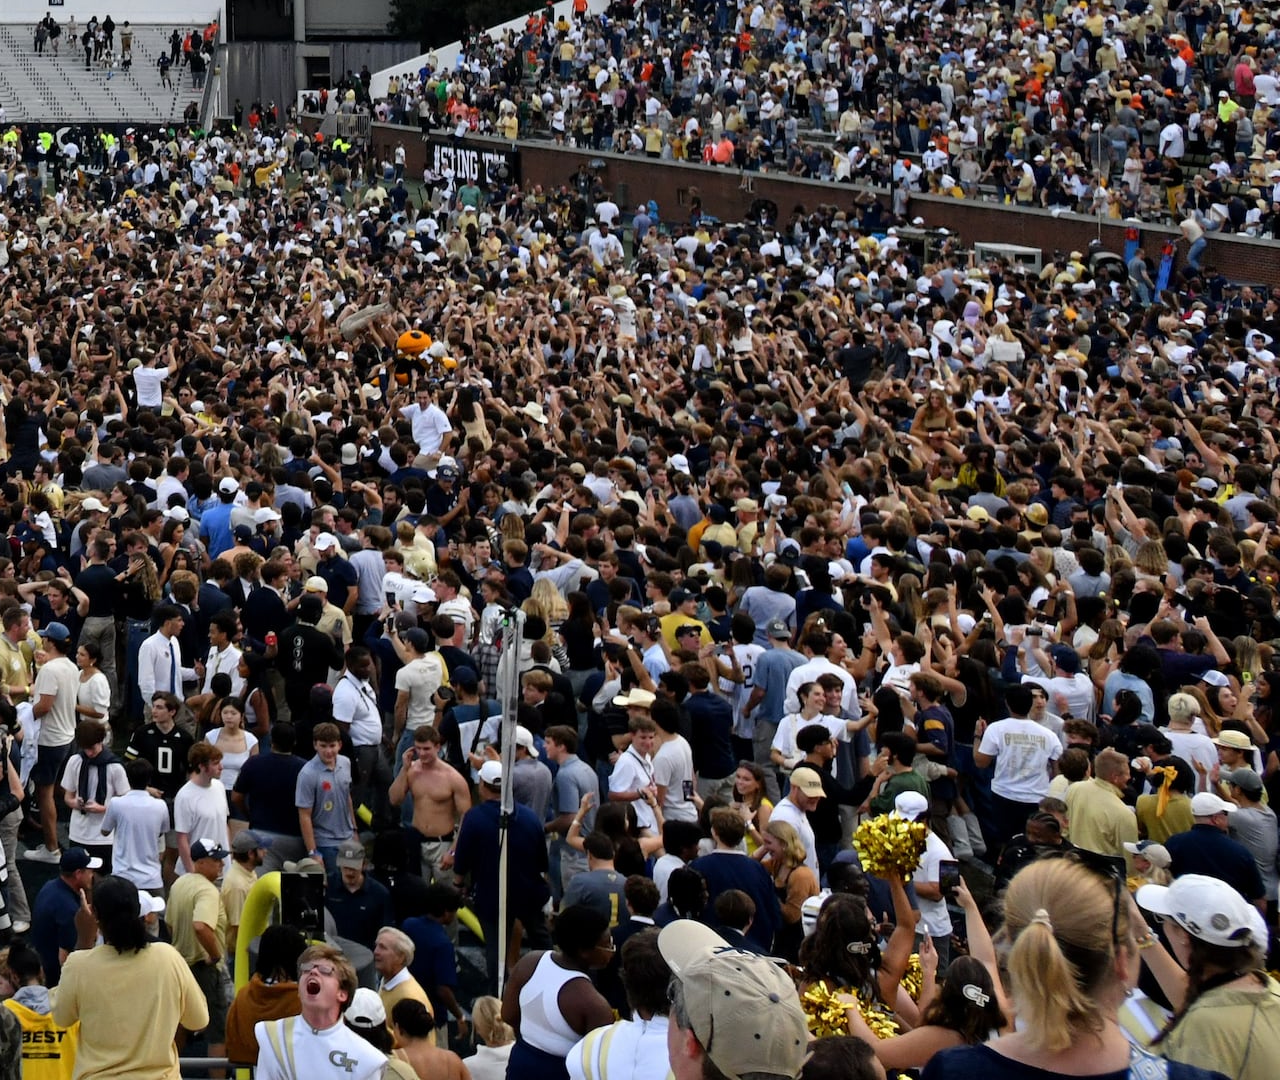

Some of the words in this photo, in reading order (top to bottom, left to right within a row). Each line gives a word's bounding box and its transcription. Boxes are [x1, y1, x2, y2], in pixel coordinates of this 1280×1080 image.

[158, 746, 173, 774] 0
[962, 983, 990, 1008] GT
[21, 1030, 68, 1044] BEST
[328, 1050, 359, 1073] GT
